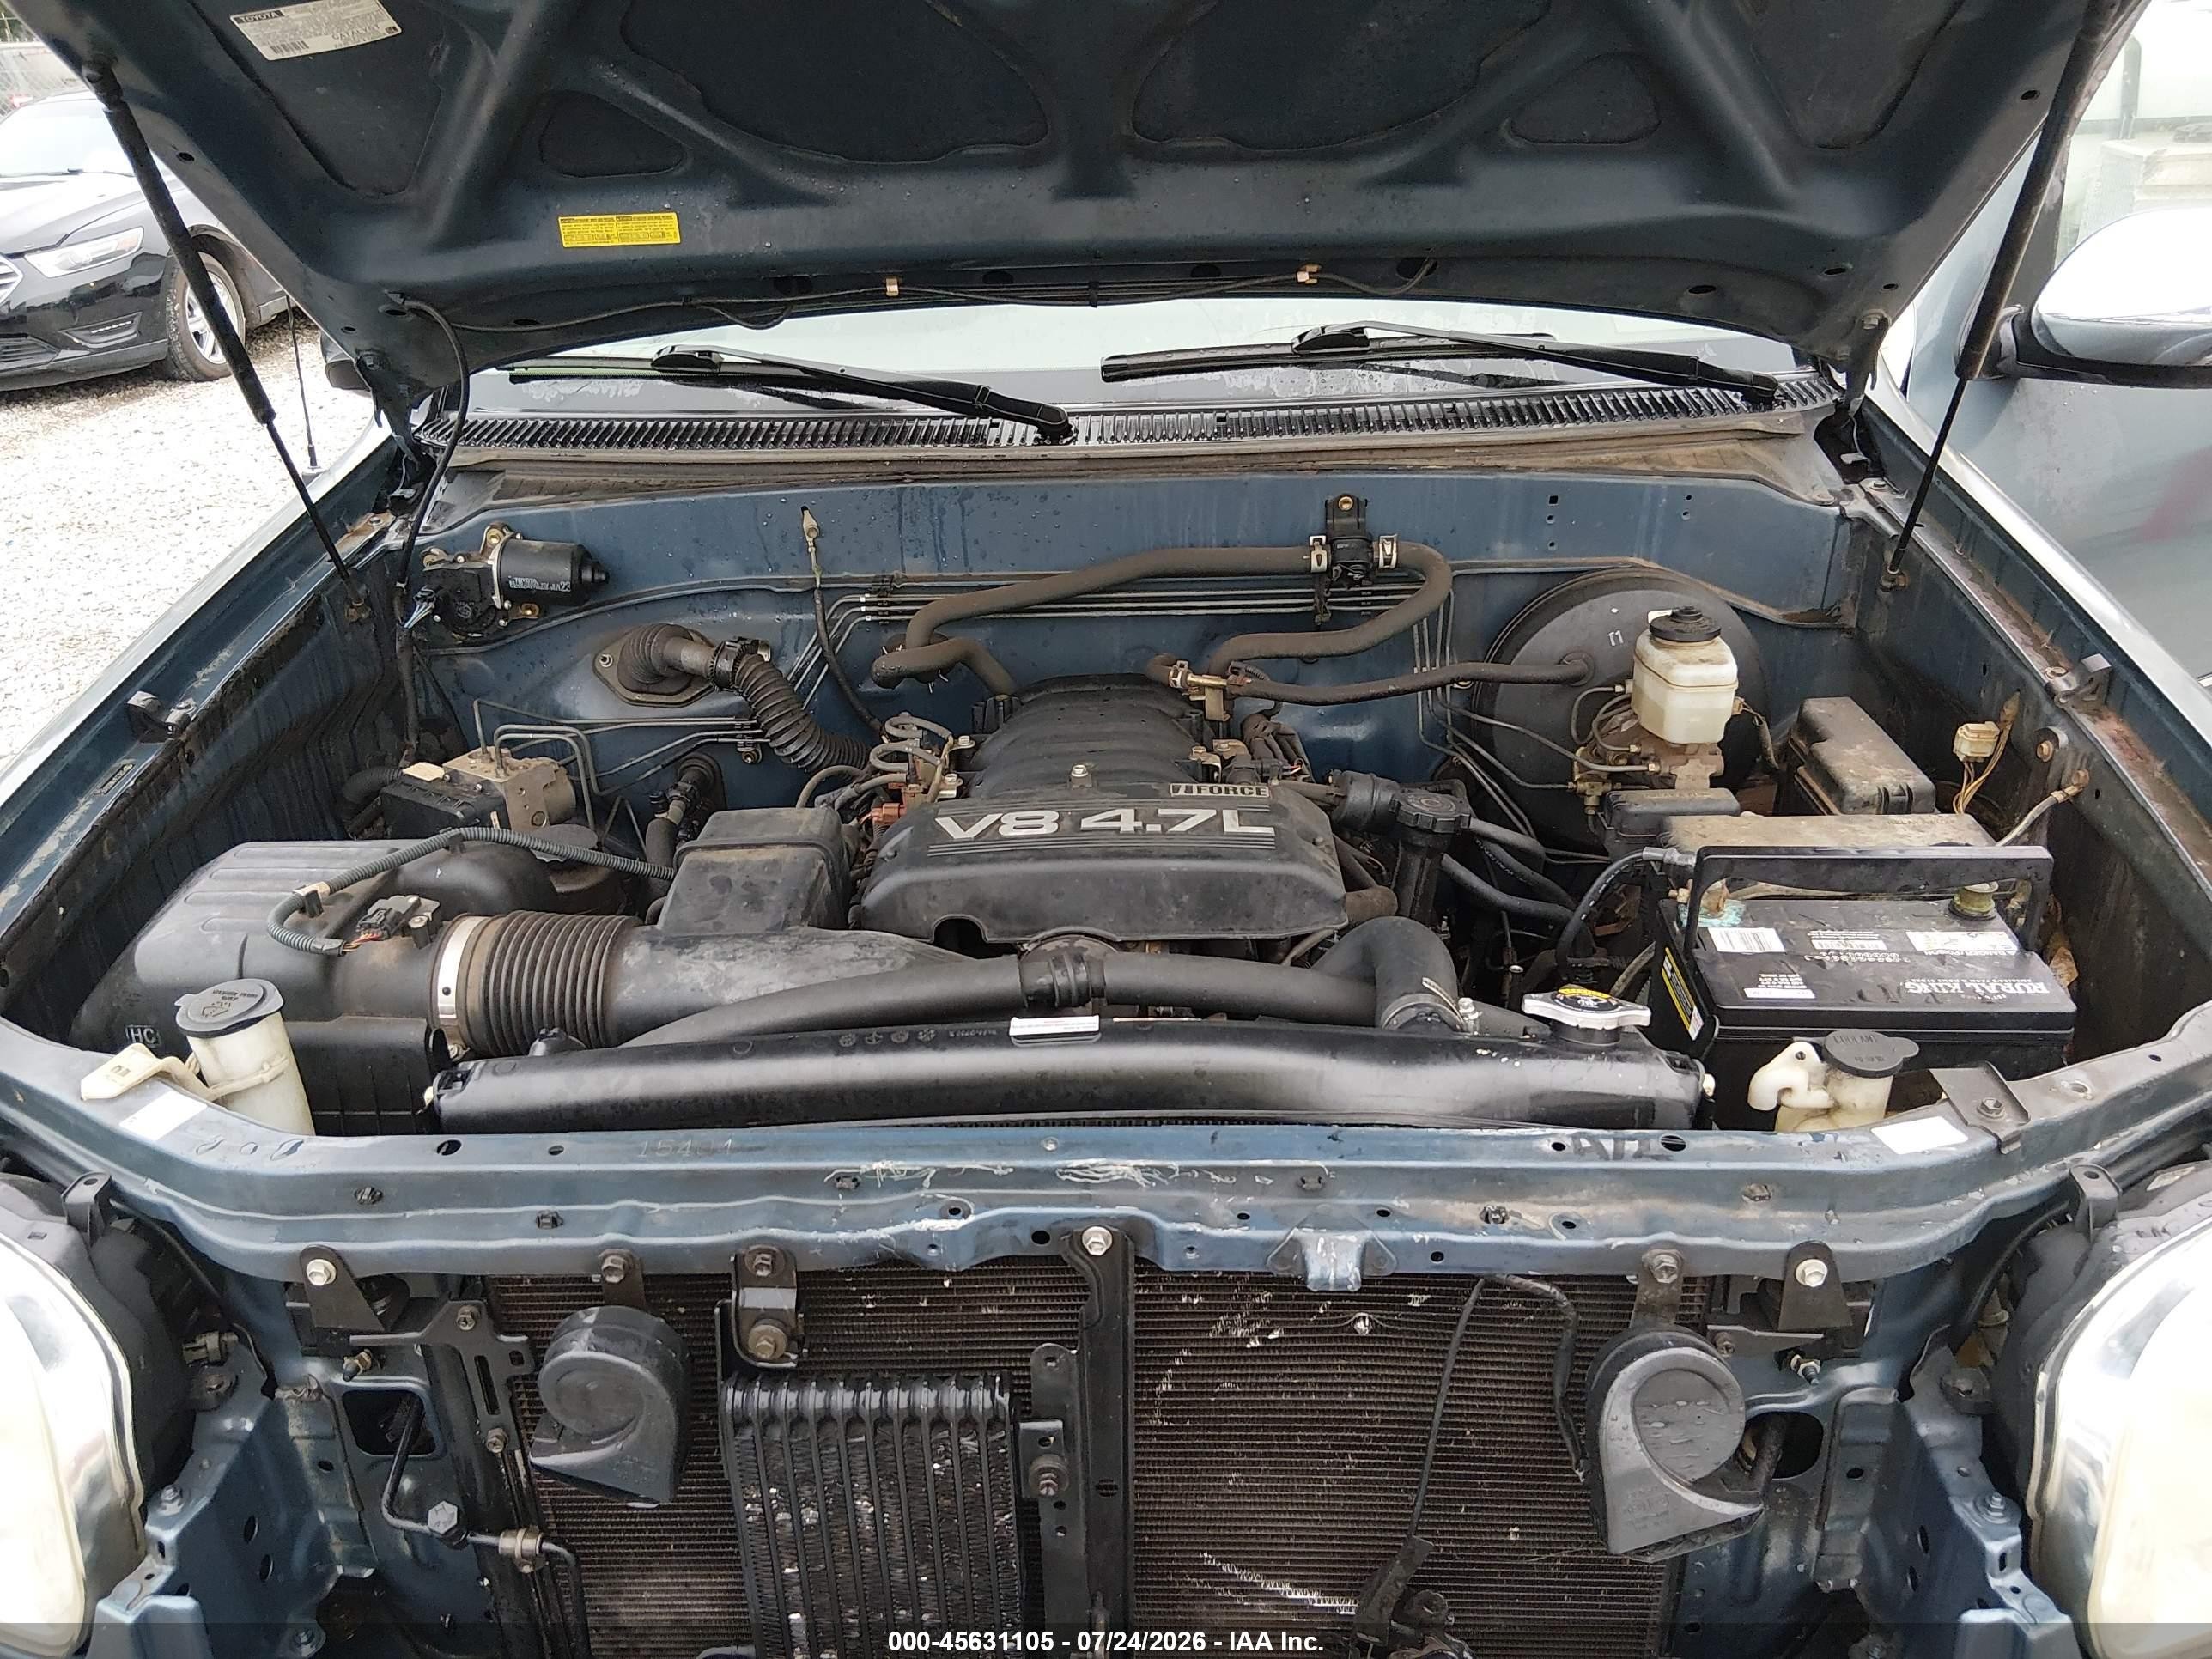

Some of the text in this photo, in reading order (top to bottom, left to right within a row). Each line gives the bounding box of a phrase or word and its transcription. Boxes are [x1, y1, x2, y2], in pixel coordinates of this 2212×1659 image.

[241, 11, 280, 23] TOYOTA
[935, 808, 1276, 840] V8 4.7L
[1905, 981, 2051, 994] RURAL KING
[130, 1027, 157, 1045] HC
